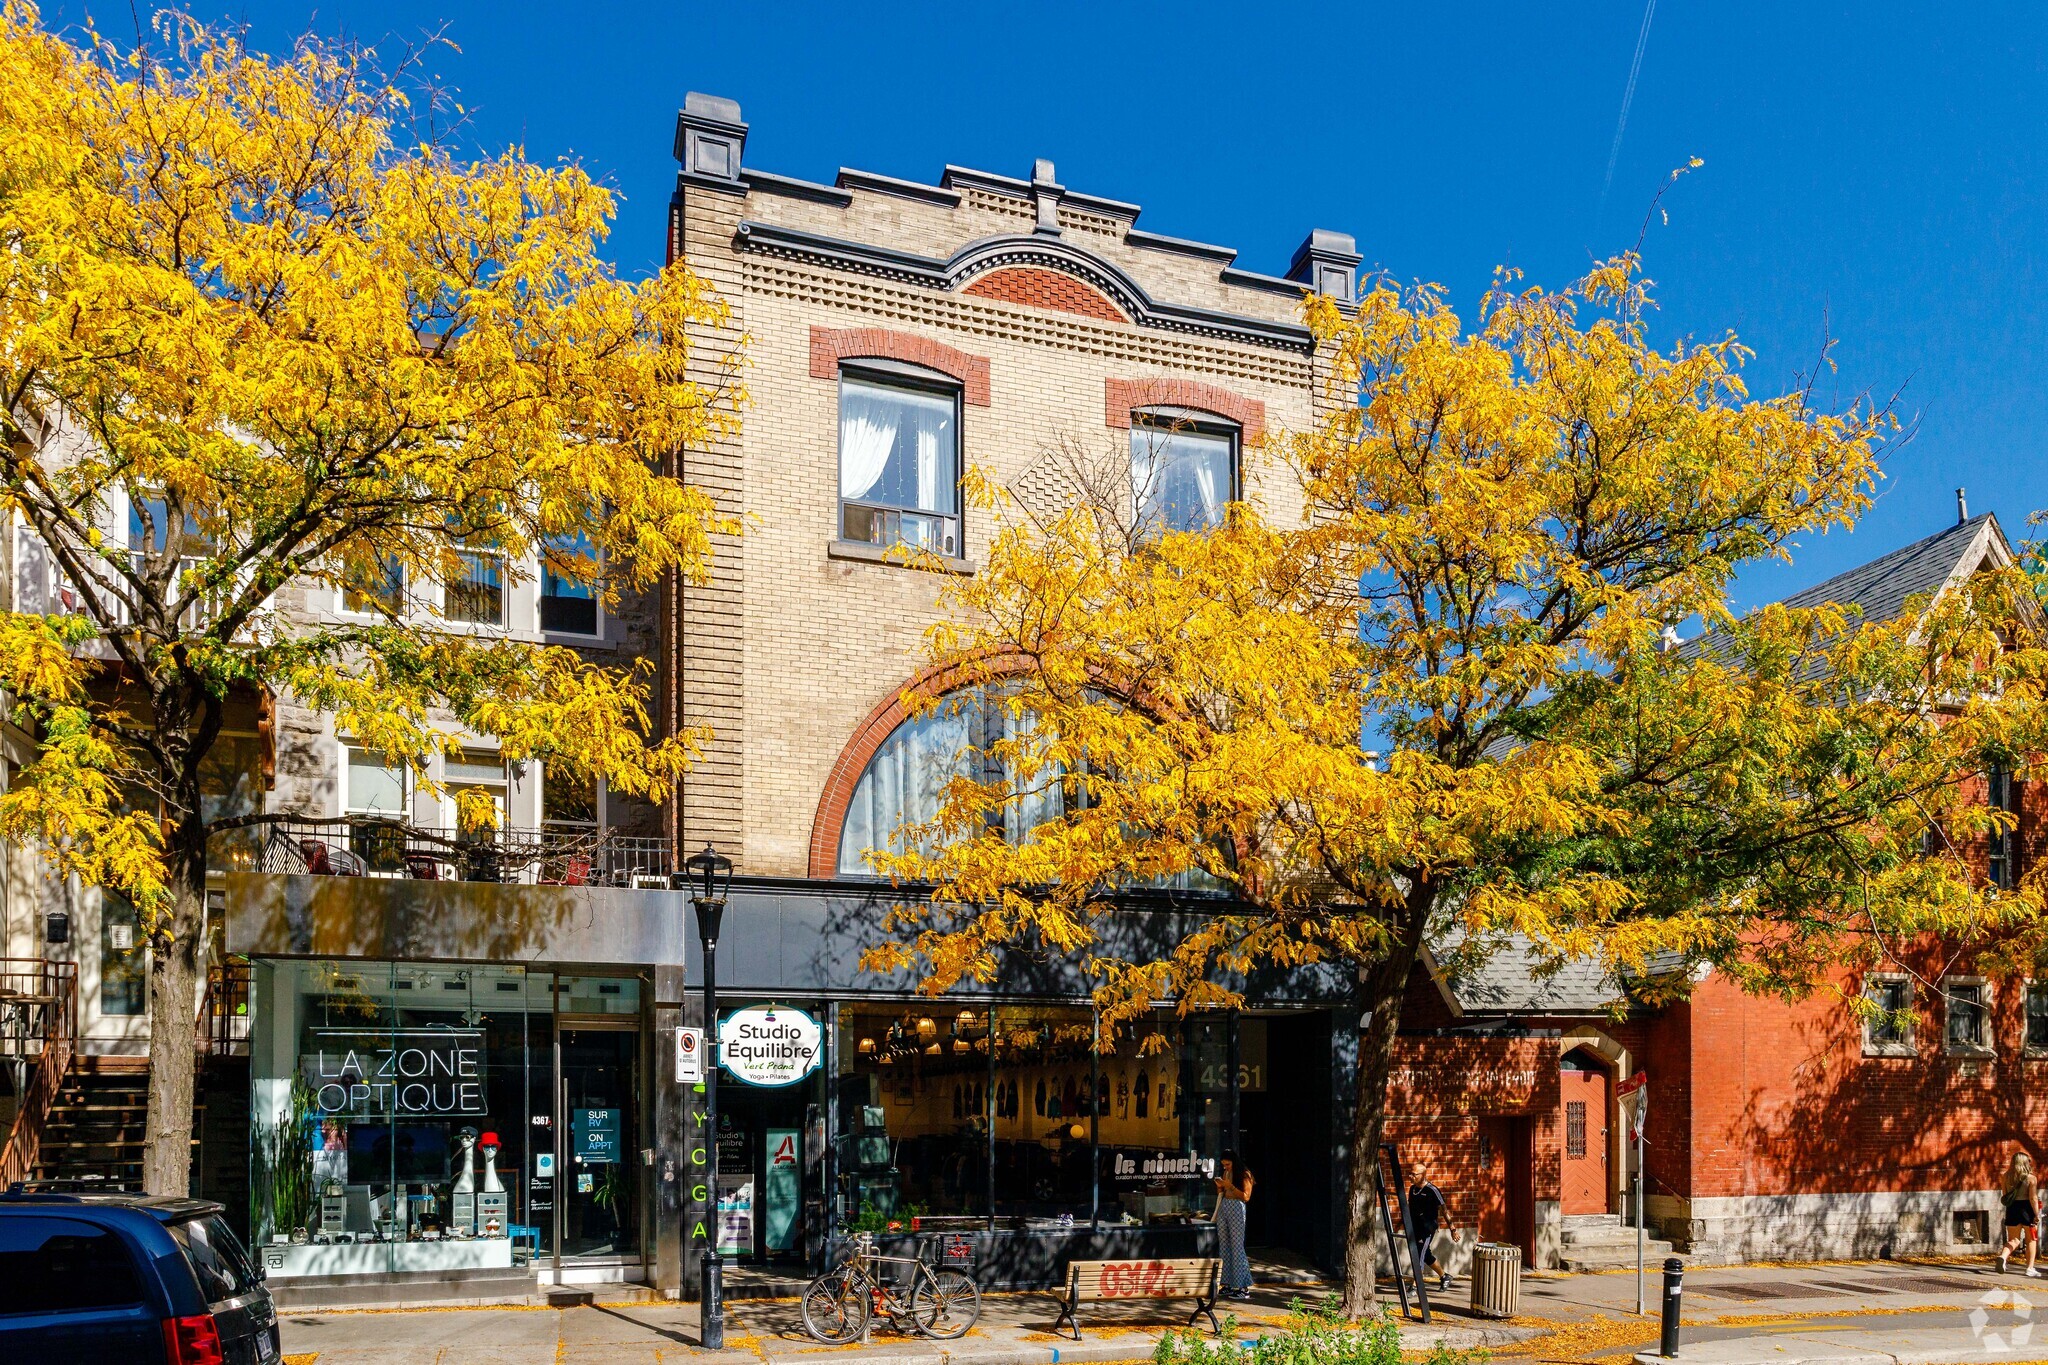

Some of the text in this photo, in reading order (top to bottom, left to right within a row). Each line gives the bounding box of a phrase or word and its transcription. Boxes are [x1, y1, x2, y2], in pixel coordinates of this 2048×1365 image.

[739, 1024, 802, 1040] Studio
[728, 1039, 813, 1061] Équilibre
[319, 1049, 479, 1077] LA ZONE
[743, 1062, 795, 1070] Vert Prana
[317, 1083, 480, 1112] OPTIQUE
[588, 1110, 608, 1119] SUR
[532, 1116, 549, 1125] 4367
[588, 1118, 602, 1127] RV
[588, 1133, 604, 1142] ON
[588, 1141, 613, 1150] APPT
[718, 1139, 744, 1147] uilibre
